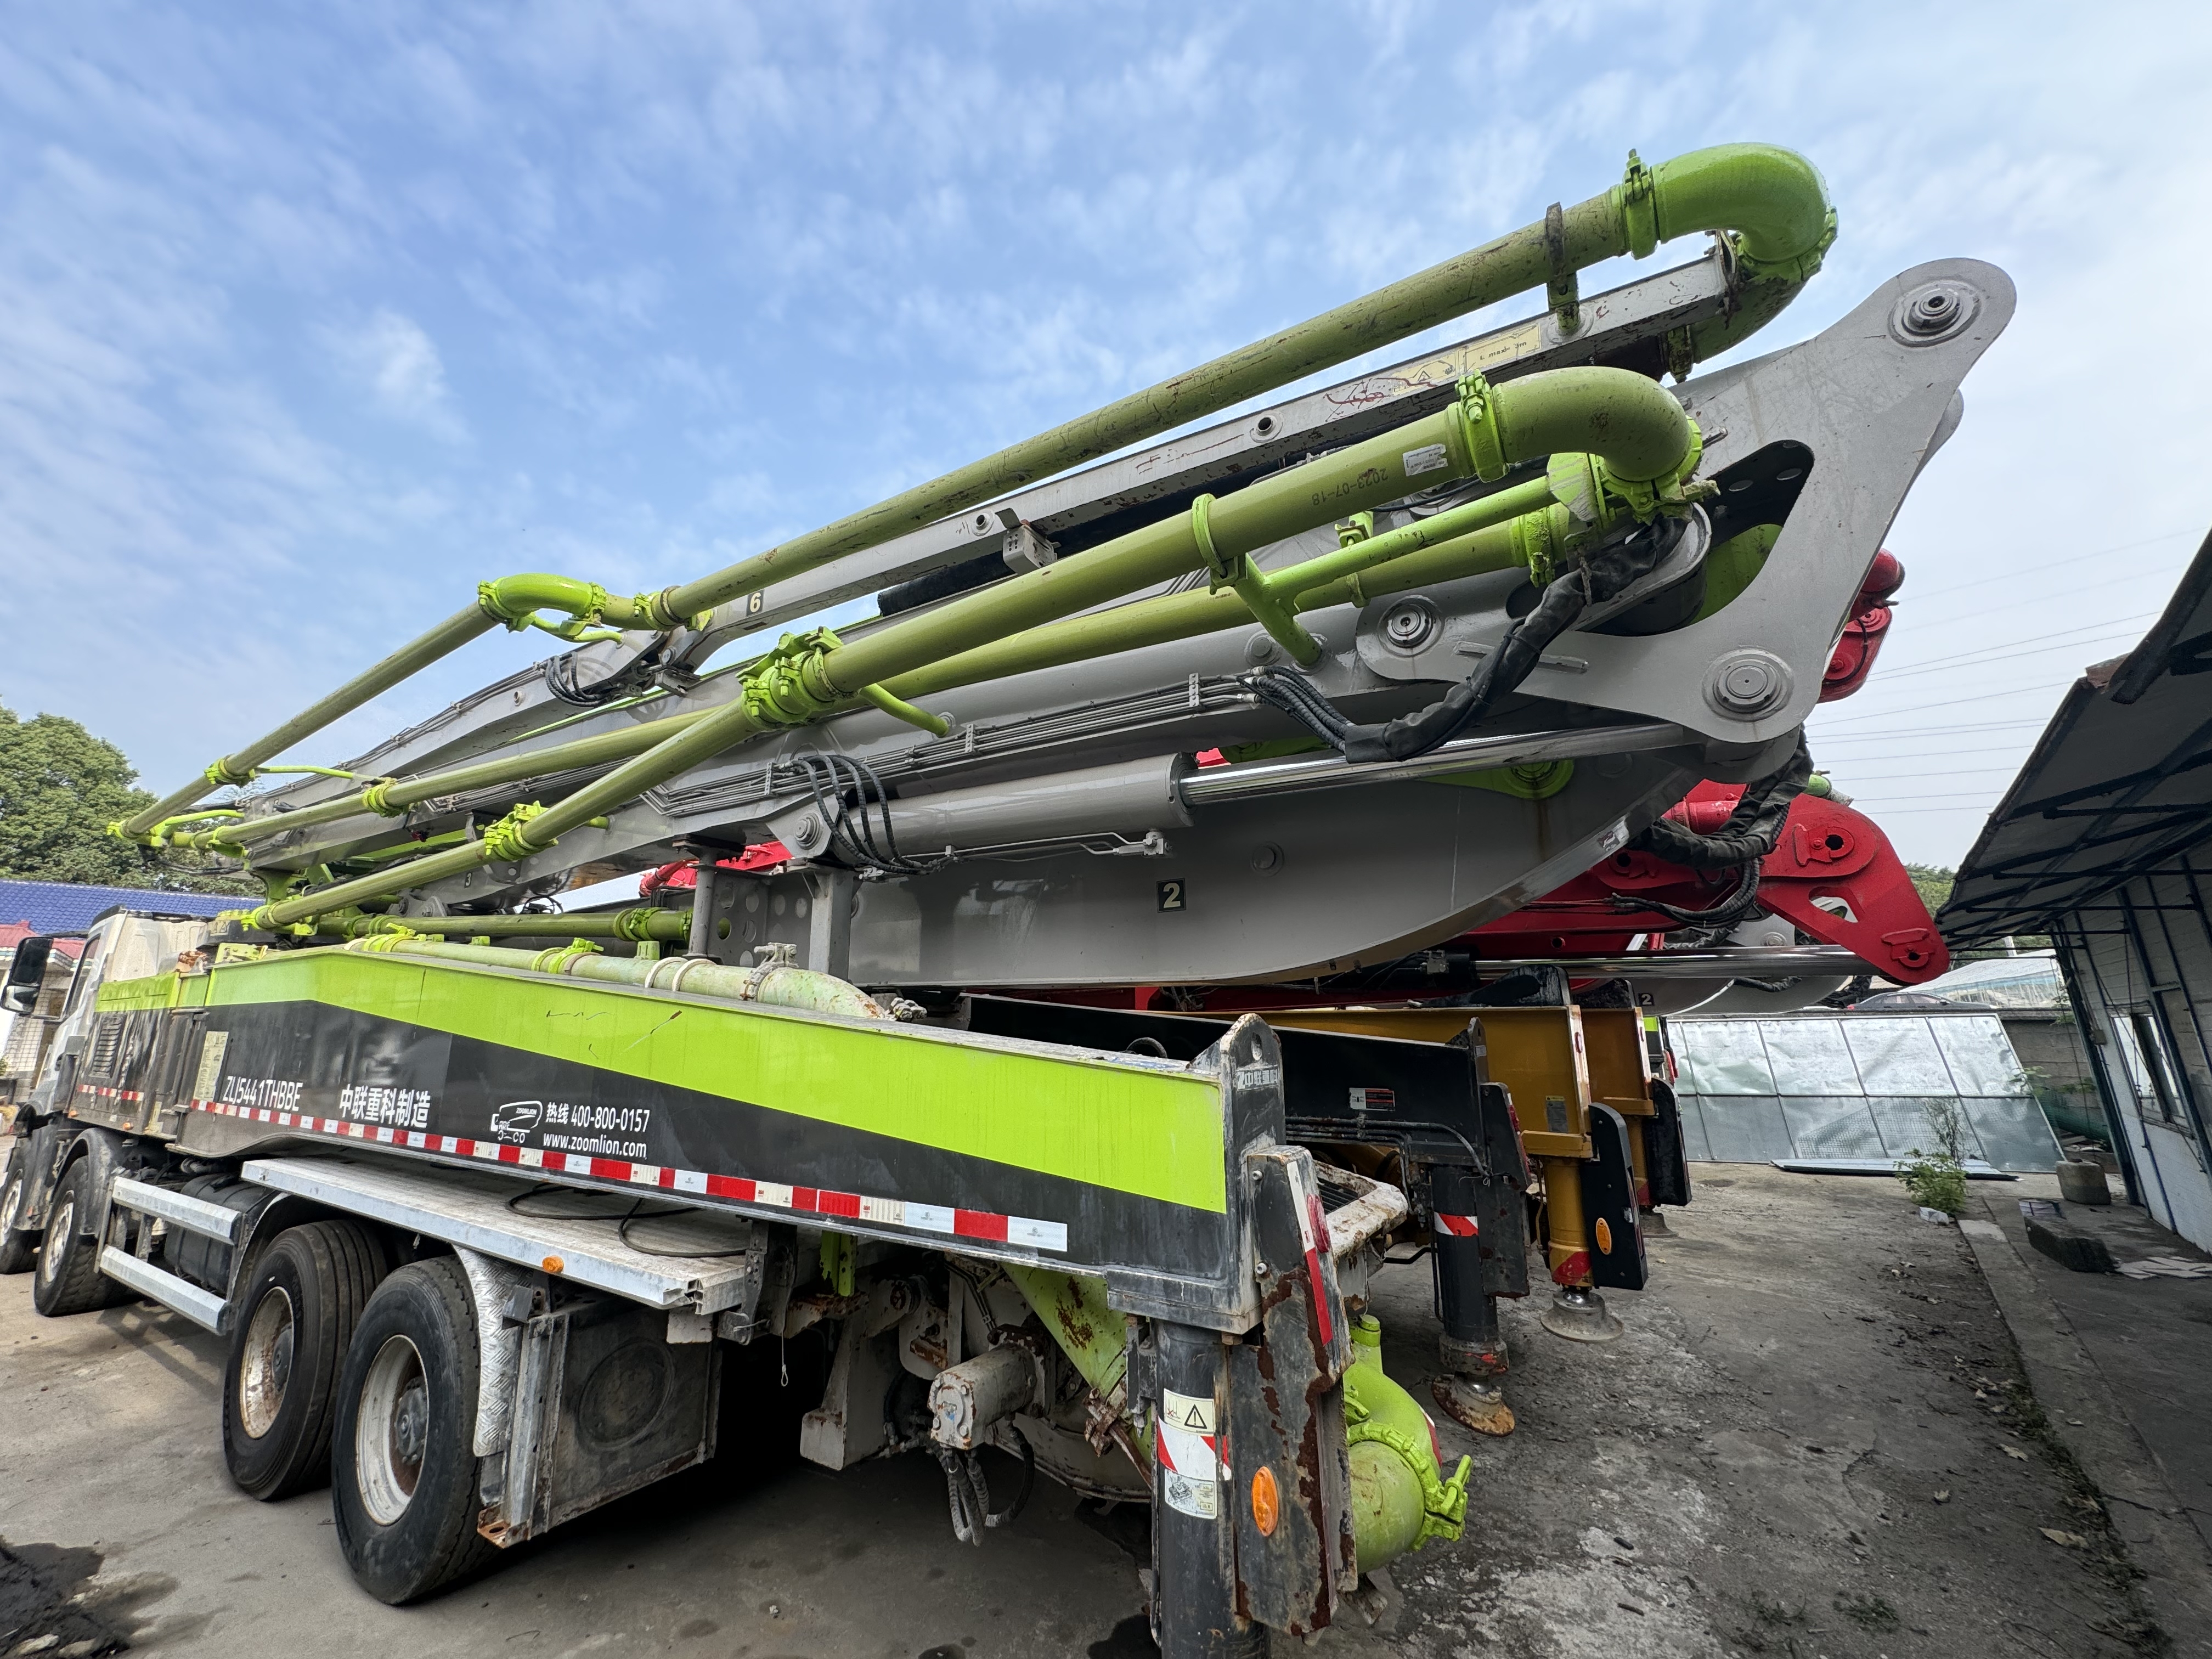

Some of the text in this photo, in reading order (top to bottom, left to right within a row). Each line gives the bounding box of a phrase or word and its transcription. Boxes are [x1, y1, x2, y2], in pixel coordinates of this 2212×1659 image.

[1311, 467, 1389, 506] 2023-07-18
[749, 592, 761, 613] 6
[465, 873, 472, 886] 3
[1163, 882, 1181, 909] 2
[1641, 994, 1652, 1005] 2
[222, 1075, 303, 1112] ZLJ5441THBBE
[338, 1084, 431, 1128] 中联重科制造
[516, 1107, 537, 1116] ZOOMLION
[545, 1102, 650, 1132] 热线 400-800-0157
[543, 1133, 647, 1159] www.zoomlion.com
